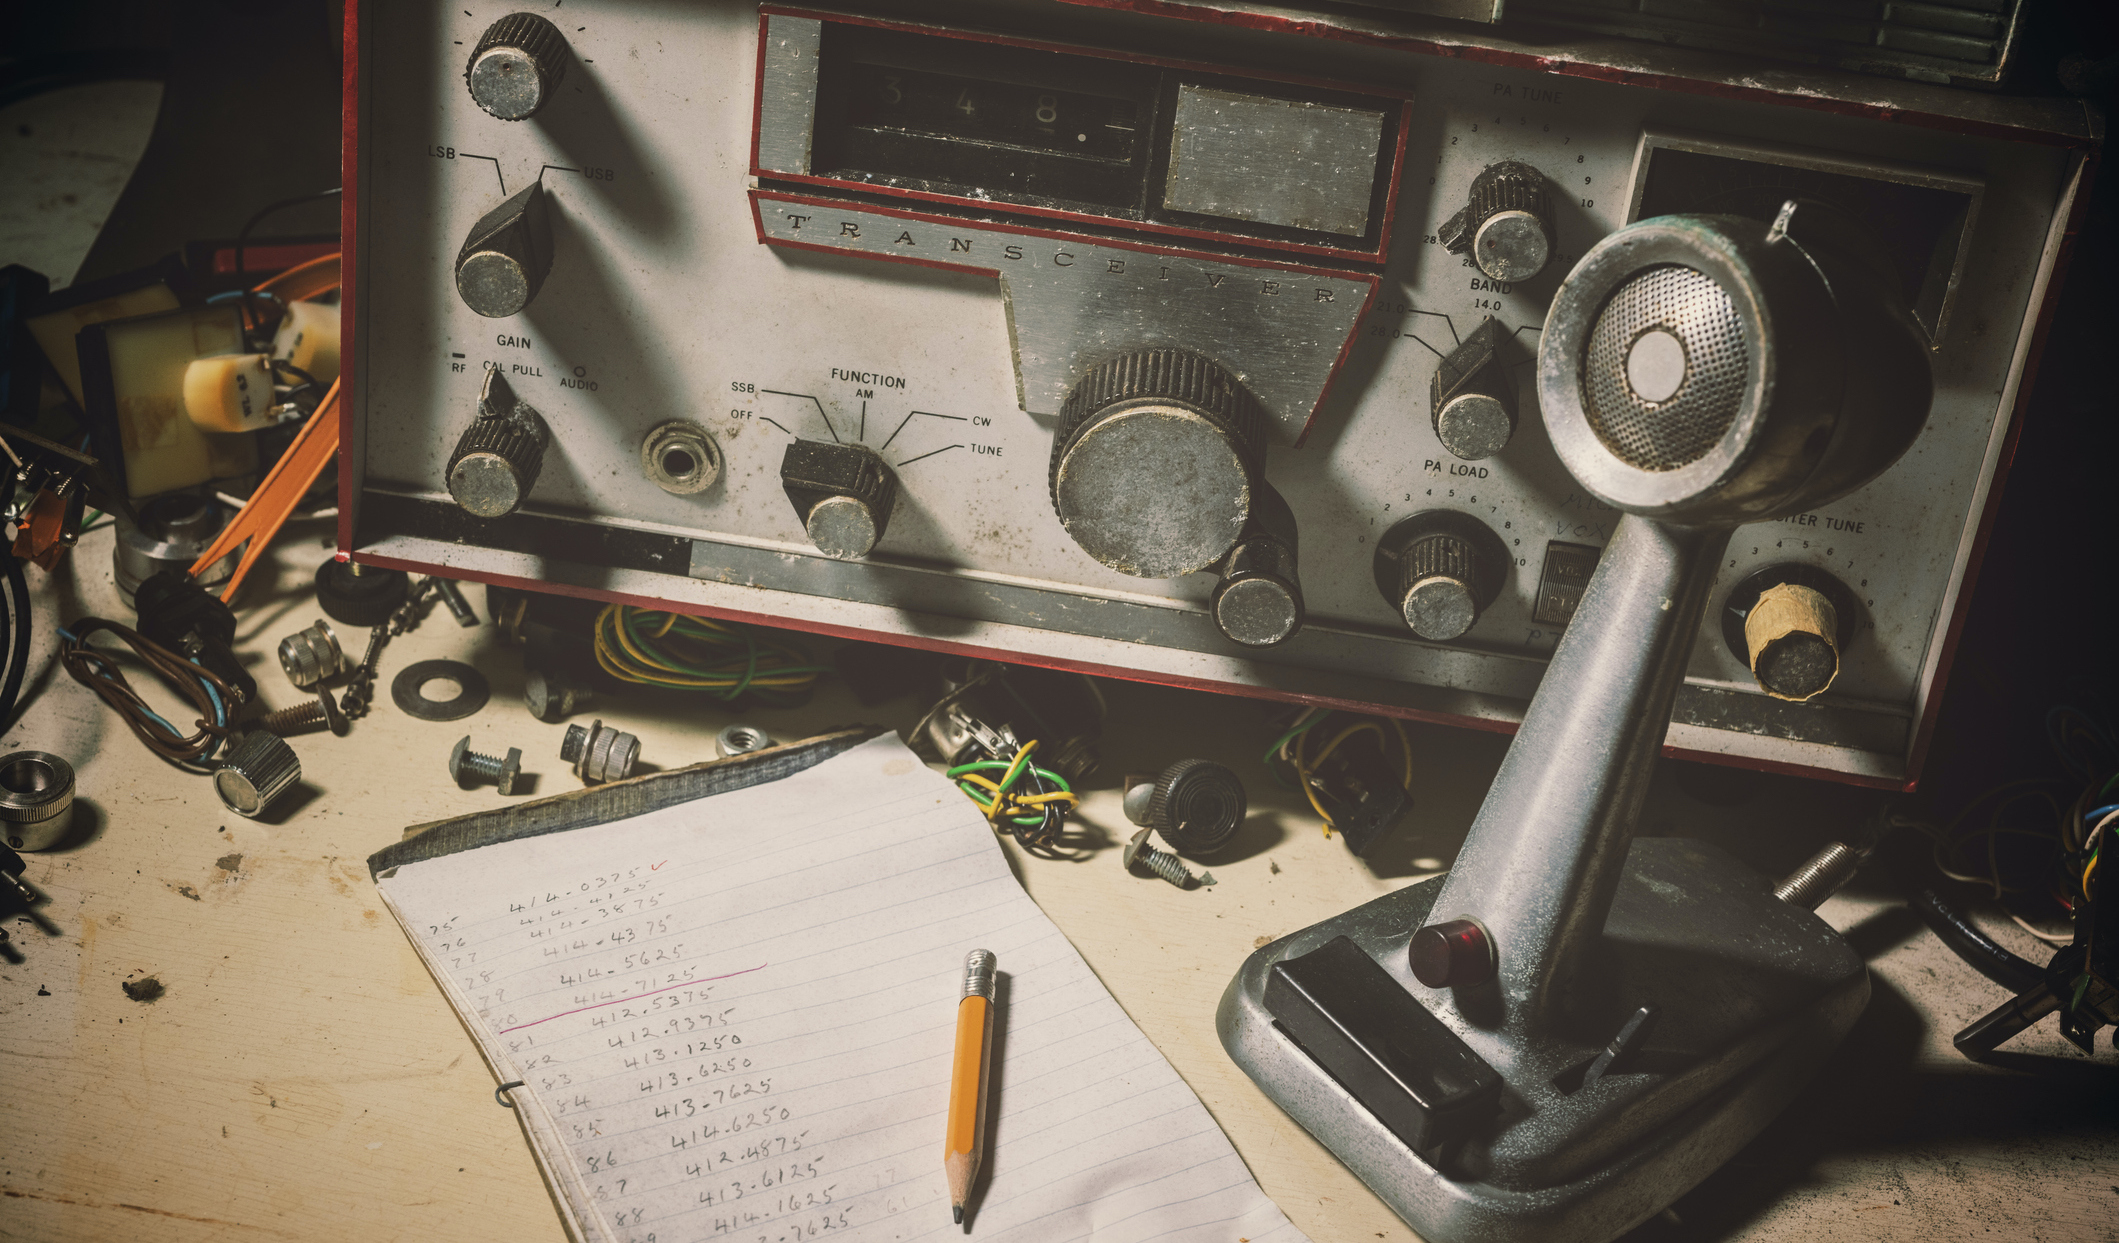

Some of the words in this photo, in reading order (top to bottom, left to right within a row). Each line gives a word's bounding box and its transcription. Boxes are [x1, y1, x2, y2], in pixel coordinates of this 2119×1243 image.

[884, 75, 902, 105] 3
[955, 88, 975, 115] 4
[1035, 94, 1058, 123] 8
[1493, 83, 1513, 97] PA
[1521, 86, 1563, 105] TUNE
[1494, 117, 1501, 125] 4
[1520, 116, 1526, 126] 5
[1471, 123, 1478, 133] 3
[1543, 123, 1550, 133] 6
[1451, 136, 1458, 146] 2
[1564, 137, 1570, 146] 7
[428, 144, 455, 159] LSB
[1437, 155, 1442, 164] 1
[1577, 155, 1584, 164] 8
[584, 166, 615, 181] USB
[1429, 176, 1435, 186] 0
[1584, 176, 1591, 185] 9
[1581, 199, 1594, 209] 10
[786, 213, 1336, 304] TRANSCEIVER
[1470, 278, 1512, 295] BAND
[1377, 301, 1406, 314] 21.0
[1474, 298, 1502, 311] 14.0
[1370, 326, 1400, 339] 28.0
[496, 334, 531, 349] GAIN
[452, 362, 466, 374] RF
[512, 364, 543, 377] PULL
[831, 367, 906, 390] FUNCTION
[560, 377, 599, 392] AUDIO
[731, 381, 755, 394] SSB
[855, 388, 874, 400] AM
[730, 408, 754, 421] OFF
[972, 415, 992, 427] CW
[970, 443, 1004, 457] TUNE
[1424, 459, 1442, 473] PA
[1450, 463, 1489, 479] LOAD
[1426, 488, 1432, 496] 4
[1448, 489, 1455, 497] 5
[1404, 493, 1411, 502] 3
[1470, 495, 1477, 504] 6
[1384, 503, 1391, 511] 2
[1491, 506, 1497, 514] 7
[1369, 517, 1374, 525] 1
[1504, 521, 1511, 529] 8
[1826, 517, 1865, 534] TUNE
[1358, 535, 1365, 543] 0
[1514, 538, 1521, 546] 9
[1776, 540, 1783, 548] 4
[1802, 540, 1809, 549] 5
[1752, 547, 1759, 555] 3
[1826, 547, 1834, 556] 6
[1513, 557, 1526, 567] 10
[1729, 560, 1736, 568] 2
[1848, 561, 1854, 569] 7
[1861, 579, 1868, 587] 8
[1867, 599, 1874, 608] 9
[1862, 620, 1874, 630] 10
[429, 915, 460, 936] 75
[440, 937, 466, 952] 76
[451, 952, 477, 969] 77
[465, 970, 496, 990] 78
[541, 1073, 572, 1090] 83
[556, 1095, 590, 1112] 84
[572, 1119, 604, 1139] 85
[586, 1150, 618, 1173] 86
[615, 1207, 644, 1227] 88
[631, 1232, 656, 1243] 9
